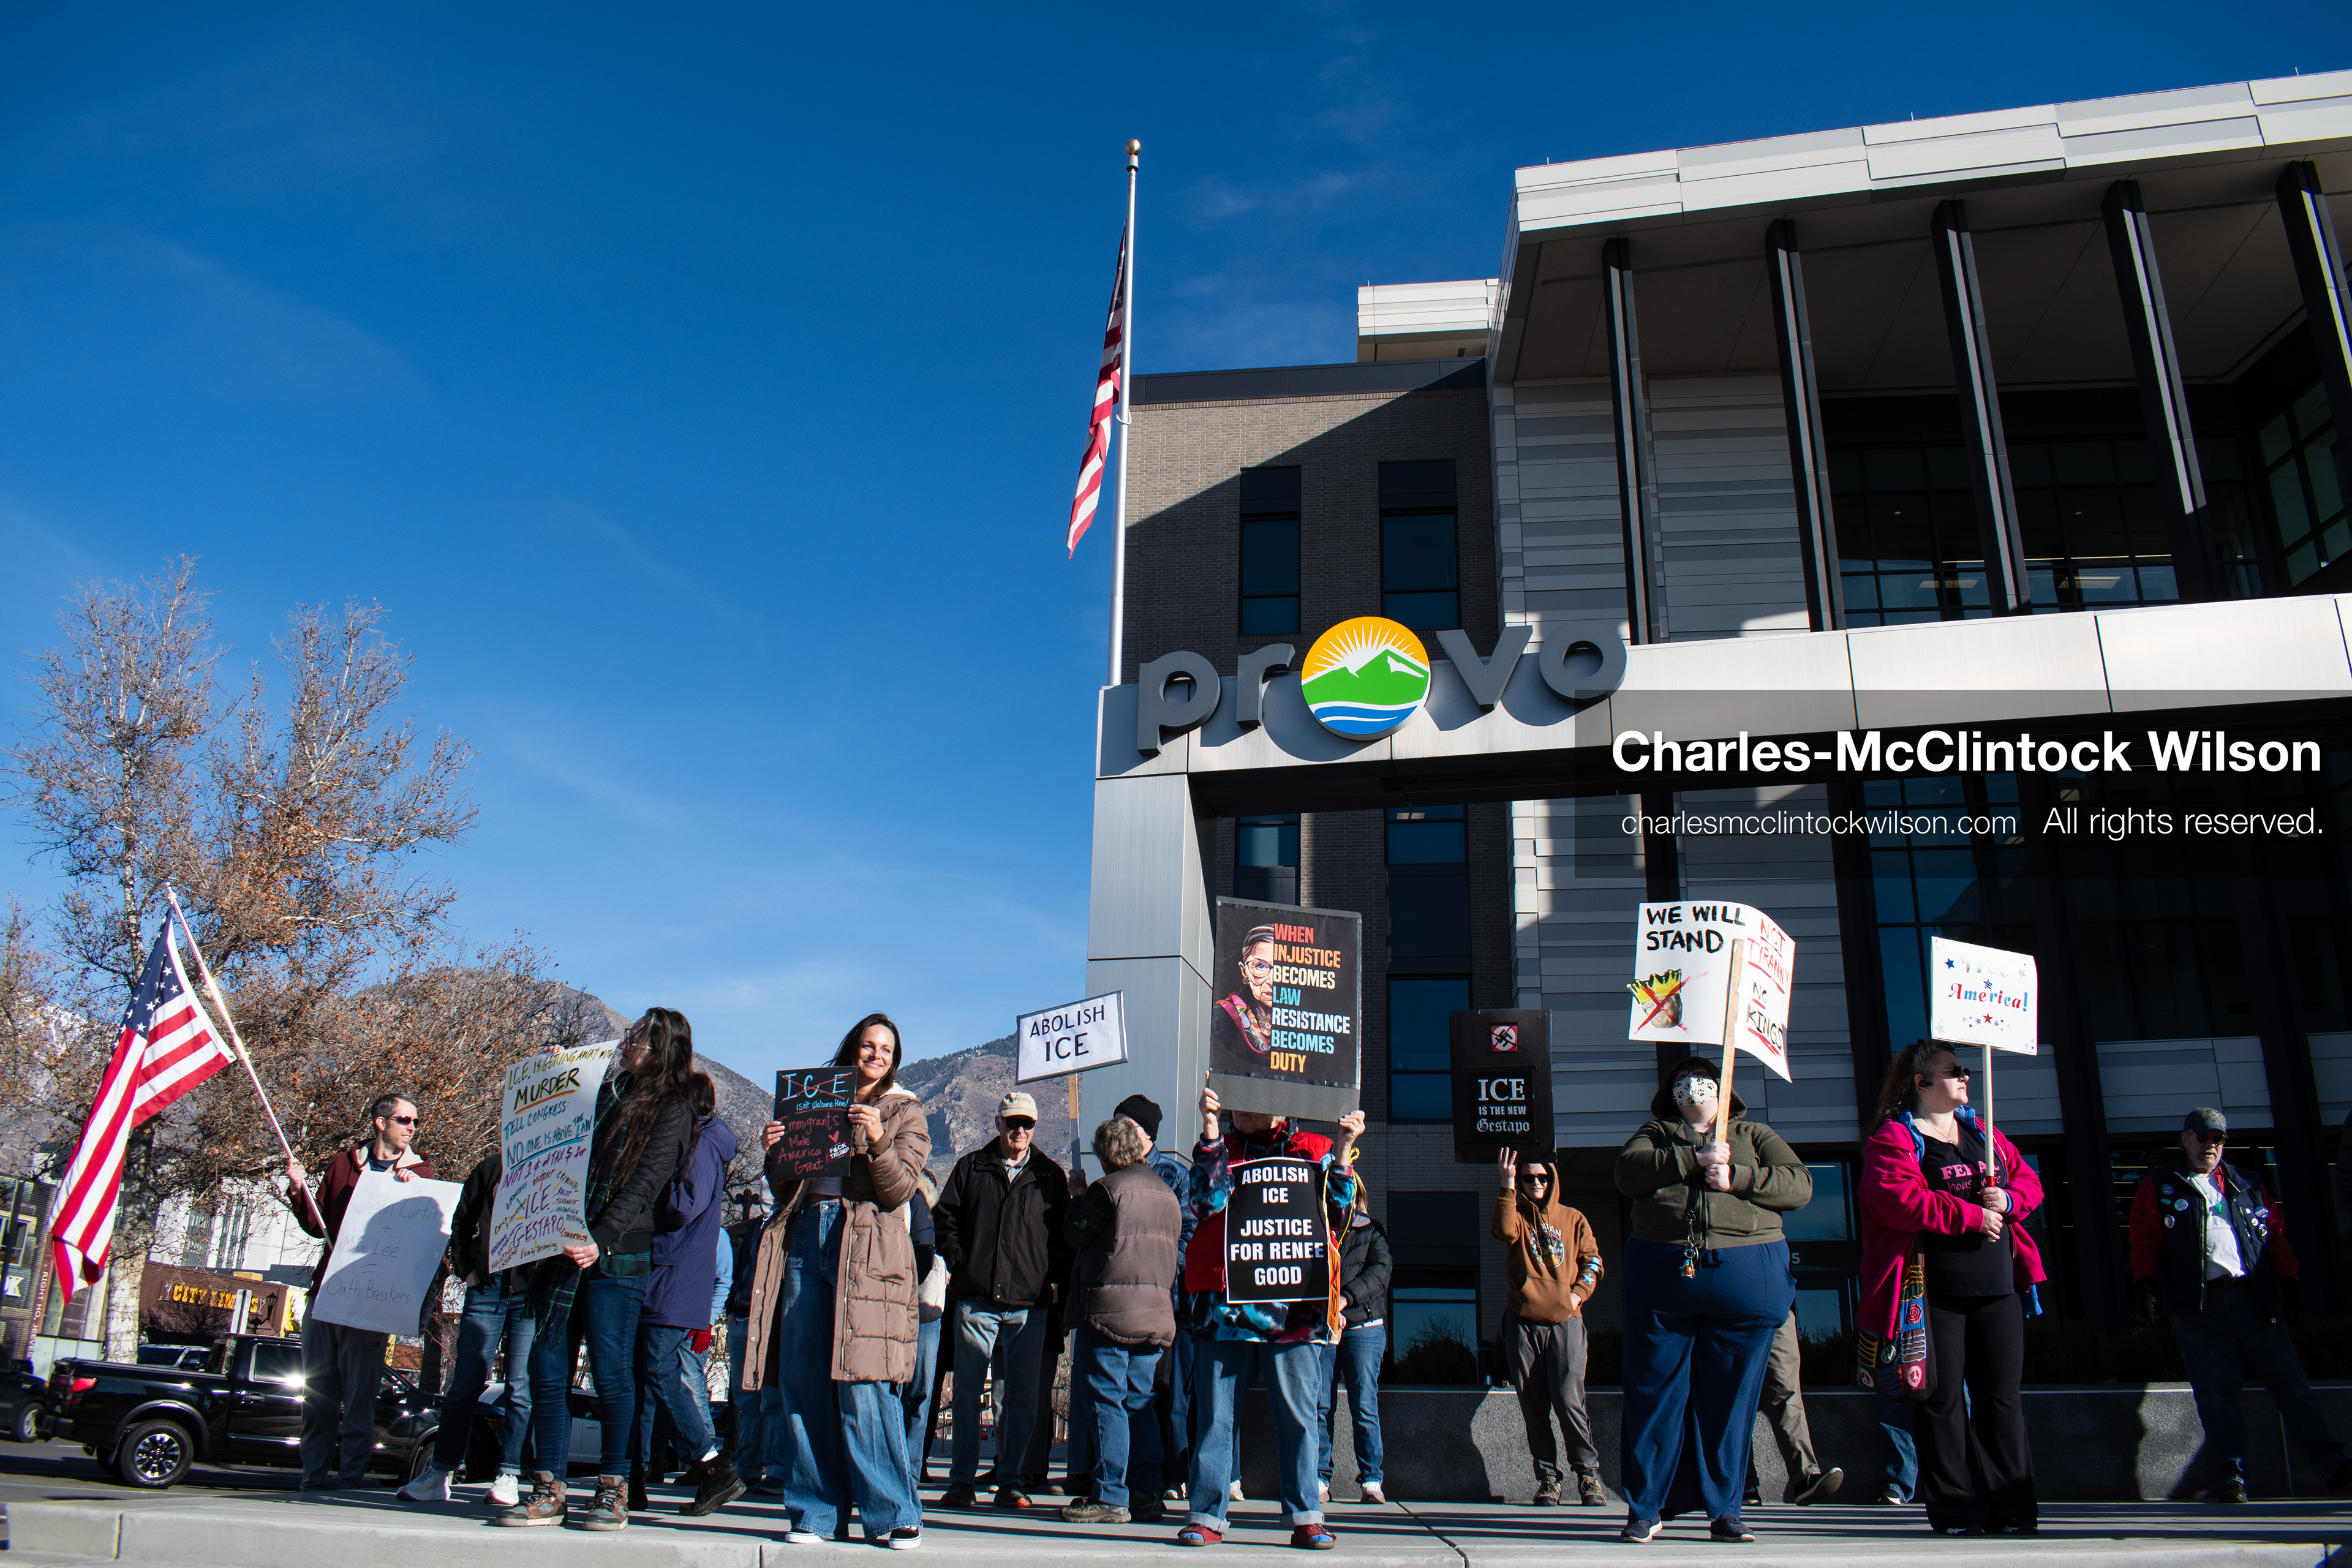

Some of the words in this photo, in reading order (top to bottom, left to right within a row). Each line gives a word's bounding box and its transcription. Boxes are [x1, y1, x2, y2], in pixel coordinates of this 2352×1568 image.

[1646, 905, 1683, 925] WE
[1692, 905, 1746, 927] WILL
[1274, 922, 1314, 944] WHEN
[1646, 929, 1725, 954] STAND
[1760, 918, 1785, 953] NOT
[1273, 944, 1341, 968] INJUSTICE
[1747, 937, 1790, 991] TYRANNY
[1273, 965, 1336, 990] BECOMES
[1272, 986, 1301, 1006] LAW
[1753, 981, 1768, 1003] NO
[1948, 983, 2027, 1012] America!
[1030, 1005, 1104, 1038] ABOLISH
[1272, 1007, 1351, 1034] RESISTANCE
[1746, 1004, 1783, 1050] KINGS
[1046, 1032, 1089, 1061] ICE
[1271, 1029, 1335, 1054] BECOMES
[507, 1061, 531, 1090] I.C.E.
[533, 1059, 541, 1074] IS
[541, 1050, 578, 1072] GETTING
[575, 1047, 601, 1061] AWAY
[1270, 1051, 1306, 1073] DUTY
[513, 1068, 581, 1111] MURDER
[1477, 1078, 1525, 1101] ICE
[812, 1099, 834, 1109] Welcome
[834, 1098, 850, 1108] Here!
[1479, 1106, 1488, 1115] IS
[1490, 1106, 1505, 1115] THE
[1507, 1106, 1526, 1115] NEW
[503, 1117, 525, 1140] TELL
[572, 1113, 584, 1126] THE
[575, 1115, 593, 1137] LAW
[1476, 1118, 1530, 1134] Gestapo
[527, 1136, 542, 1153] ONE
[544, 1131, 551, 1145] IS
[552, 1123, 573, 1144] ABOVE
[788, 1134, 810, 1148] Make
[507, 1141, 524, 1167] NO
[778, 1147, 822, 1164] America
[829, 1147, 850, 1159] TRUMP
[500, 1163, 526, 1190] NOT
[551, 1148, 565, 1166] TAX
[565, 1145, 573, 1166] $
[1242, 1166, 1309, 1185] ABOLISH
[355, 1185, 393, 1216] John
[400, 1191, 439, 1220] Curtis
[525, 1184, 551, 1219] I.C.E.
[1262, 1188, 1289, 1204] ICE
[513, 1215, 564, 1250] GESTAPO
[1240, 1219, 1313, 1237] JUSTICE
[341, 1235, 366, 1253] Mike
[372, 1238, 400, 1258] Lee
[1231, 1243, 1264, 1261] FOR
[1270, 1242, 1324, 1260] RENEE
[37, 1272, 49, 1302] RIGHT
[1254, 1266, 1302, 1286] GOOD
[173, 1284, 208, 1305] CITY
[209, 1291, 258, 1313] LIMS
[326, 1274, 360, 1299] Oath
[366, 1279, 410, 1304] Breakers
[26, 1323, 39, 1358] JEEVES
